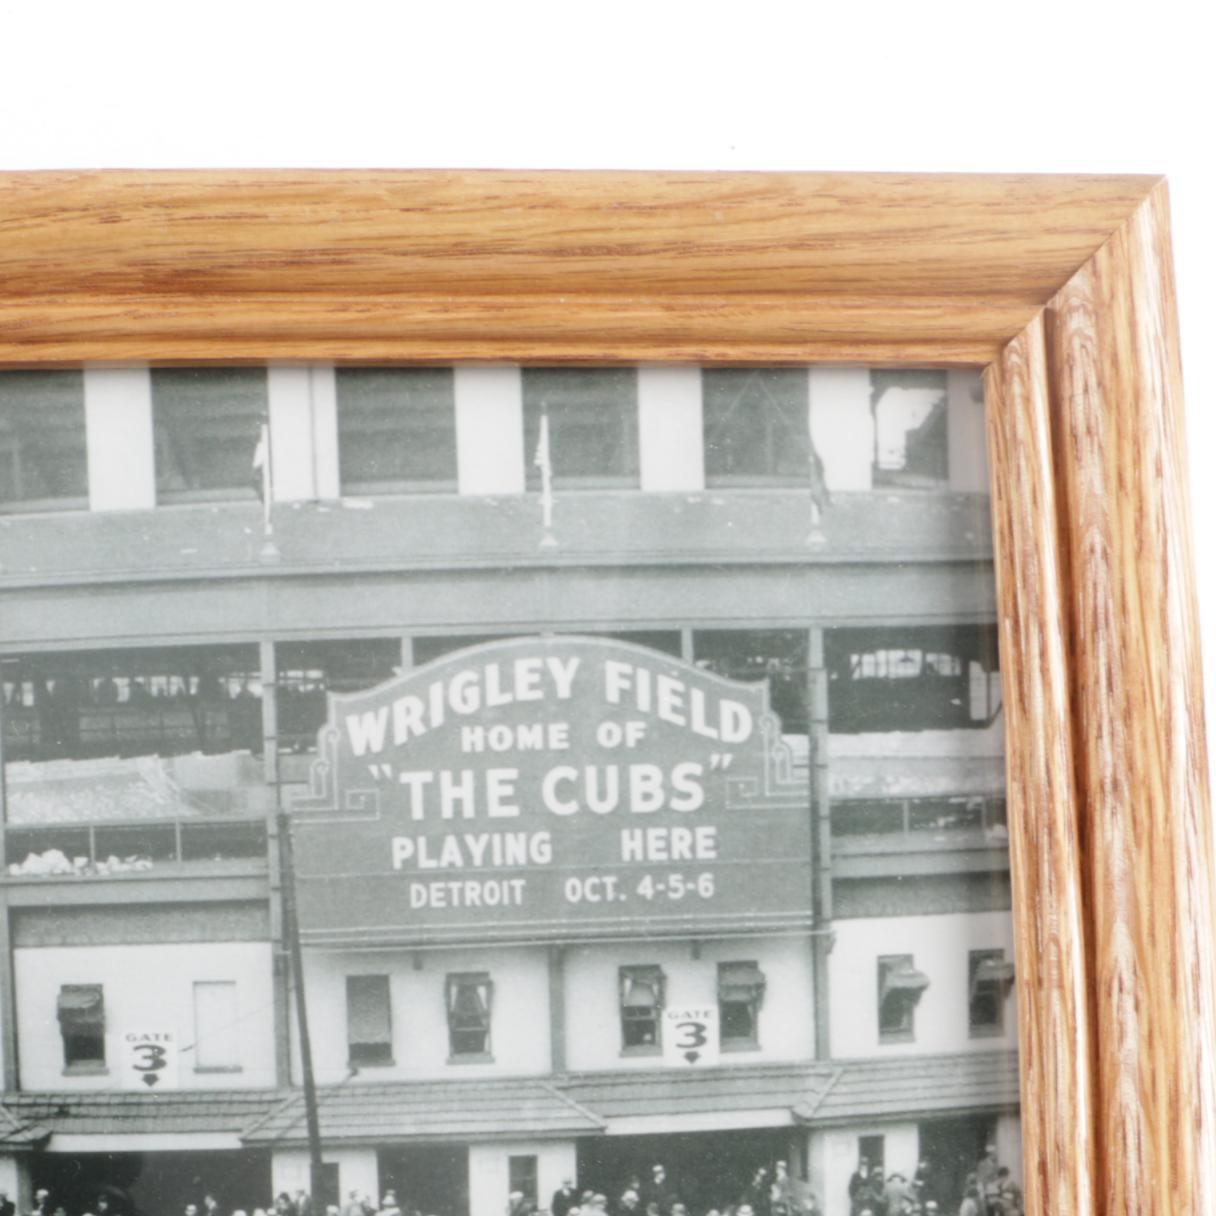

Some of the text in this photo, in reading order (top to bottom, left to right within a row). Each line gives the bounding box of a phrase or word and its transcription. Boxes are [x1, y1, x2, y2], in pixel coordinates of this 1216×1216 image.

[346, 656, 753, 757] WRIGLEY FIELD
[461, 720, 648, 753] HOME OF
[368, 753, 733, 820] "THE CUBS"
[391, 826, 717, 870] PLAYING HERE
[410, 873, 715, 908] DETROIT OCT. 4-5-6
[667, 1009, 712, 1020] GATE
[125, 1033, 172, 1043] GATE
[675, 1021, 707, 1049] 3
[132, 1044, 167, 1073] 3
